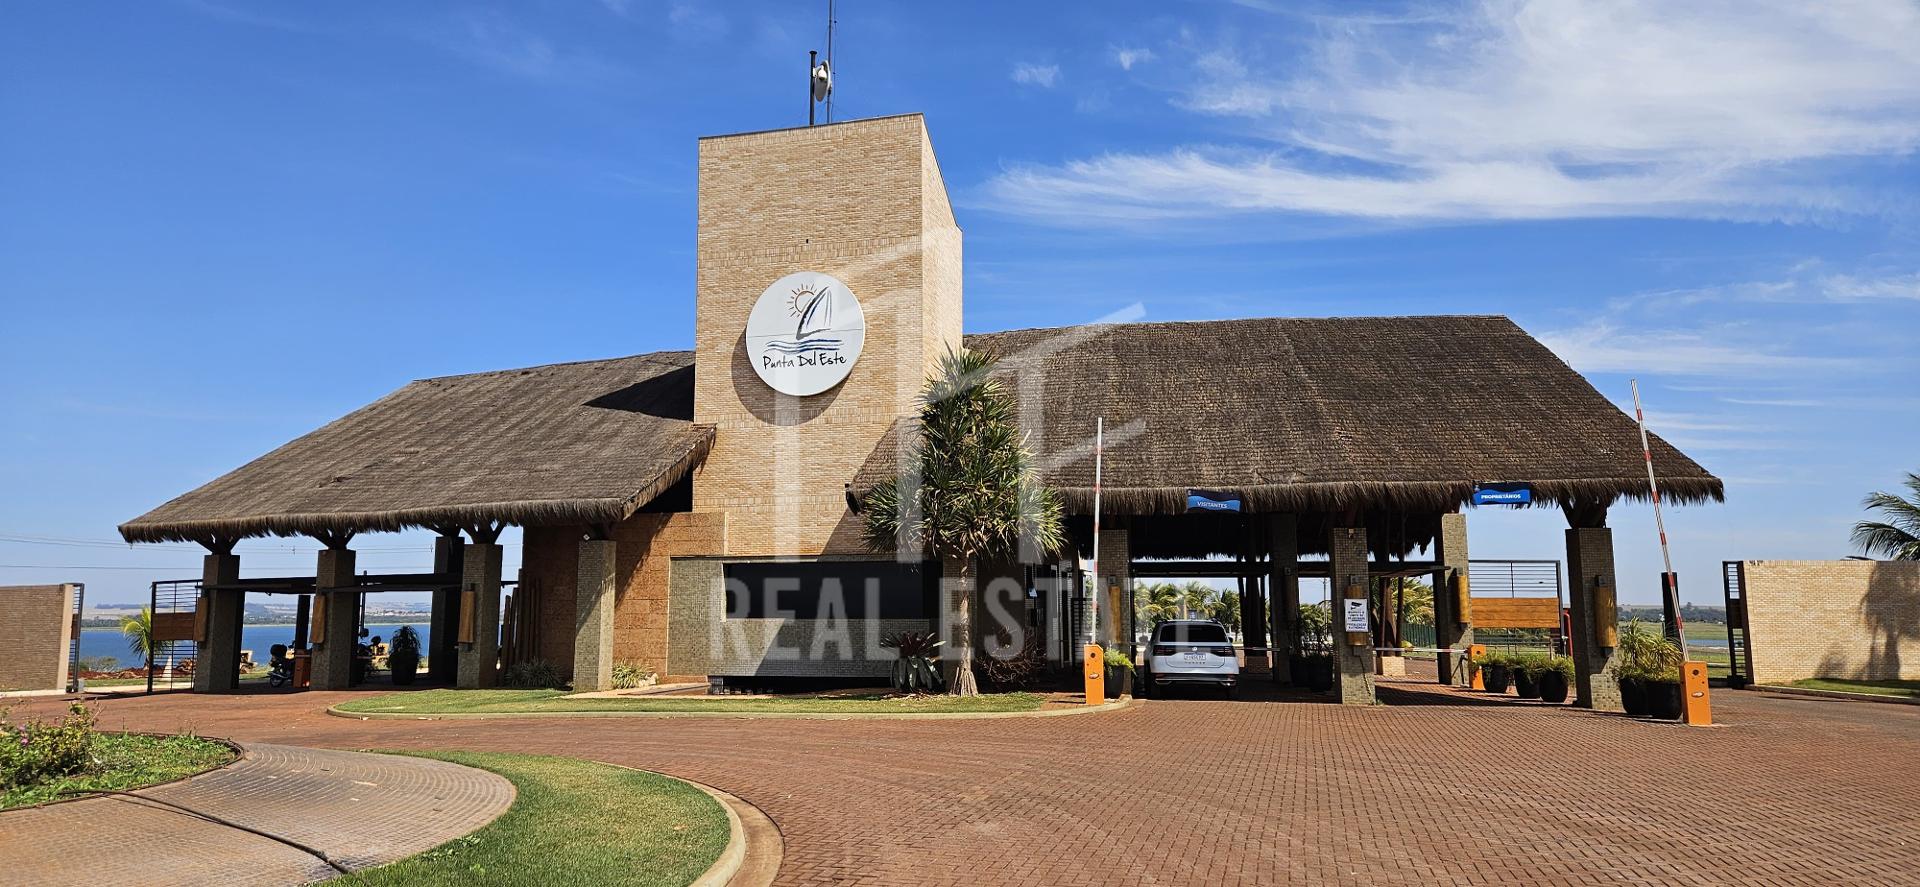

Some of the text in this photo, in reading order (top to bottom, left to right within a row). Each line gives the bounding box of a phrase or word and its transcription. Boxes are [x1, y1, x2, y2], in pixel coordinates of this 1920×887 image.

[762, 351, 847, 370] Punta Del Este
[1197, 501, 1228, 509] VISITANTES
